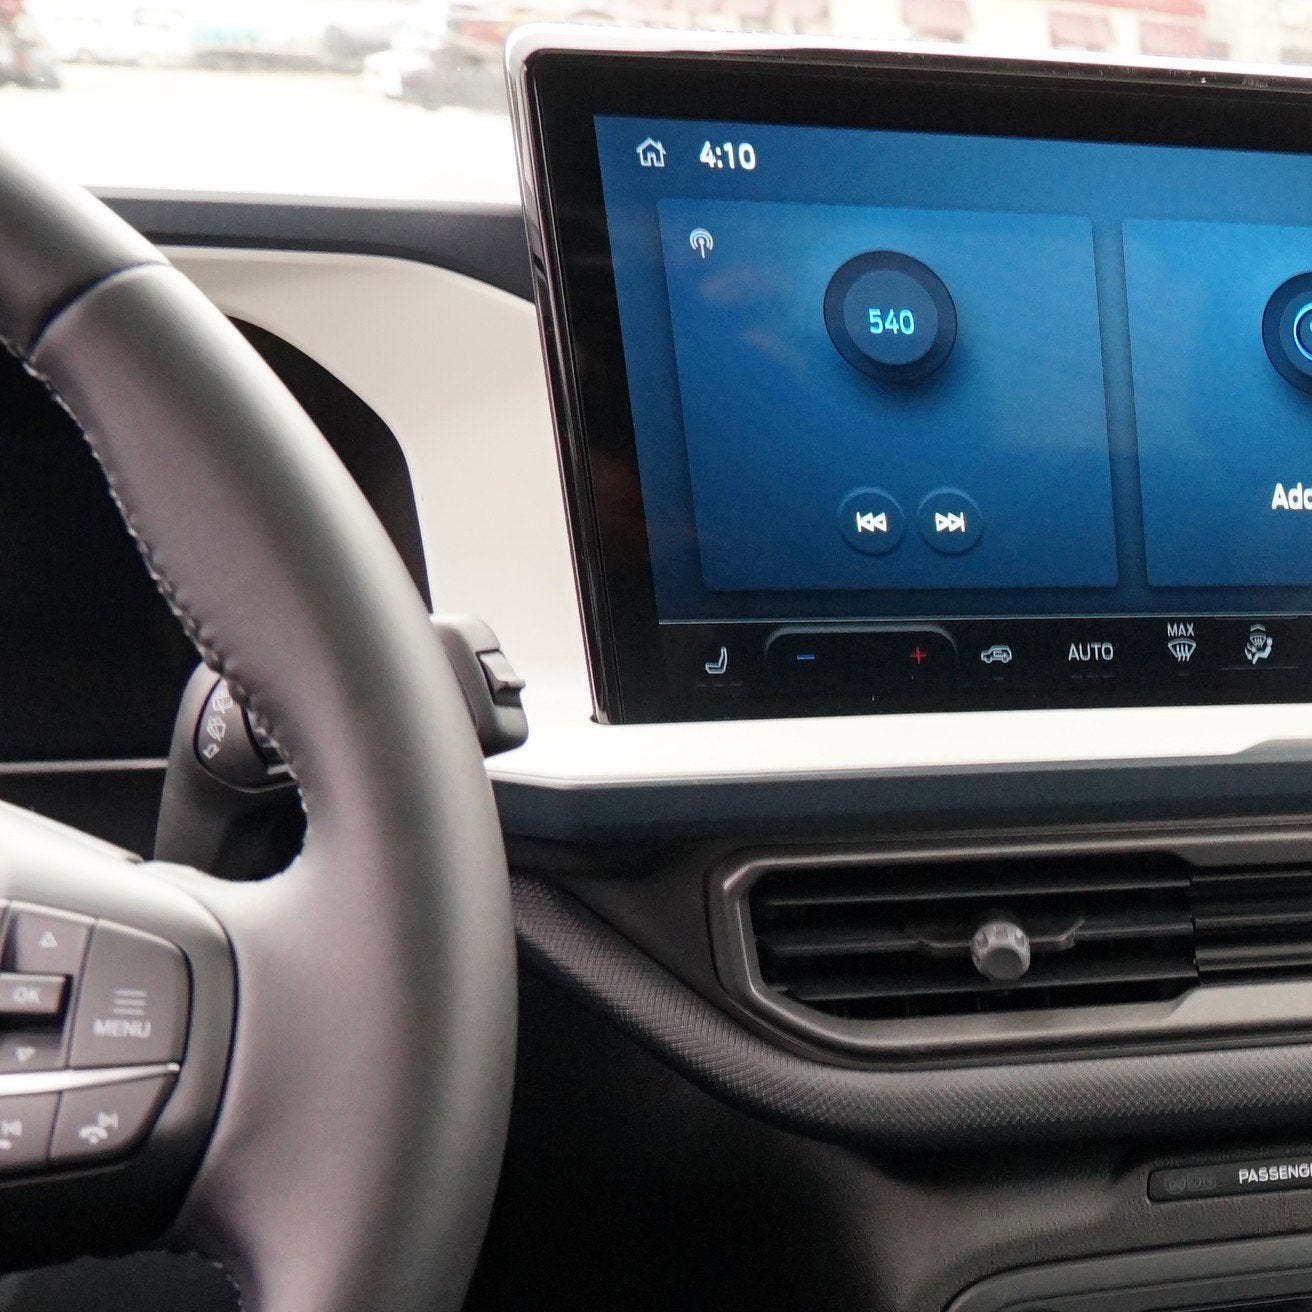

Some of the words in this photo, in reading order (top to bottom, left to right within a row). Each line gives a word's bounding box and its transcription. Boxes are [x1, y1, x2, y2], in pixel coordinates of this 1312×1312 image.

[699, 140, 757, 170] 4:10
[868, 308, 915, 335] 540
[1166, 622, 1195, 638] MAX
[1068, 641, 1114, 661] AUTO
[92, 1018, 151, 1039] MENU
